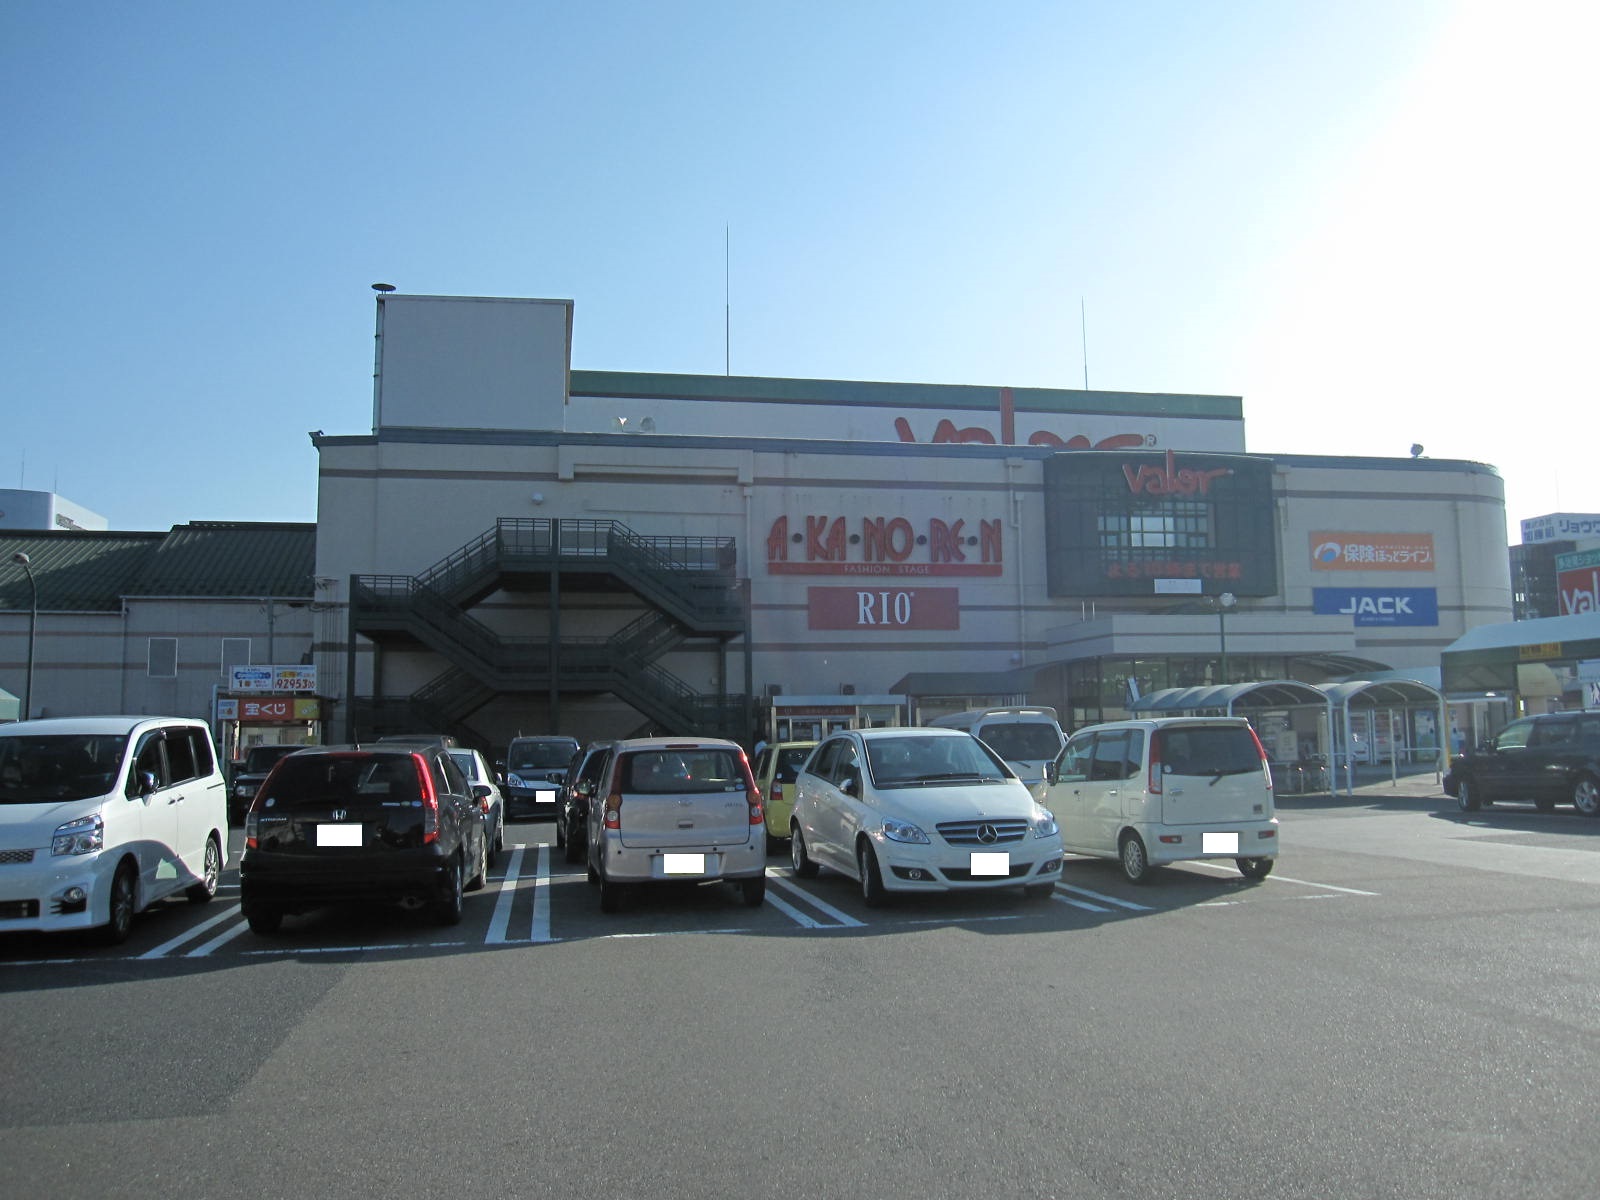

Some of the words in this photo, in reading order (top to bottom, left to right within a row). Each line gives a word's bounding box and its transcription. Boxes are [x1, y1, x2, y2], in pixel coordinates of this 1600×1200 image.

[844, 564, 890, 575] FASHION
[898, 564, 930, 575] STAGE
[856, 591, 911, 625] RIO
[1338, 596, 1414, 615] JACK
